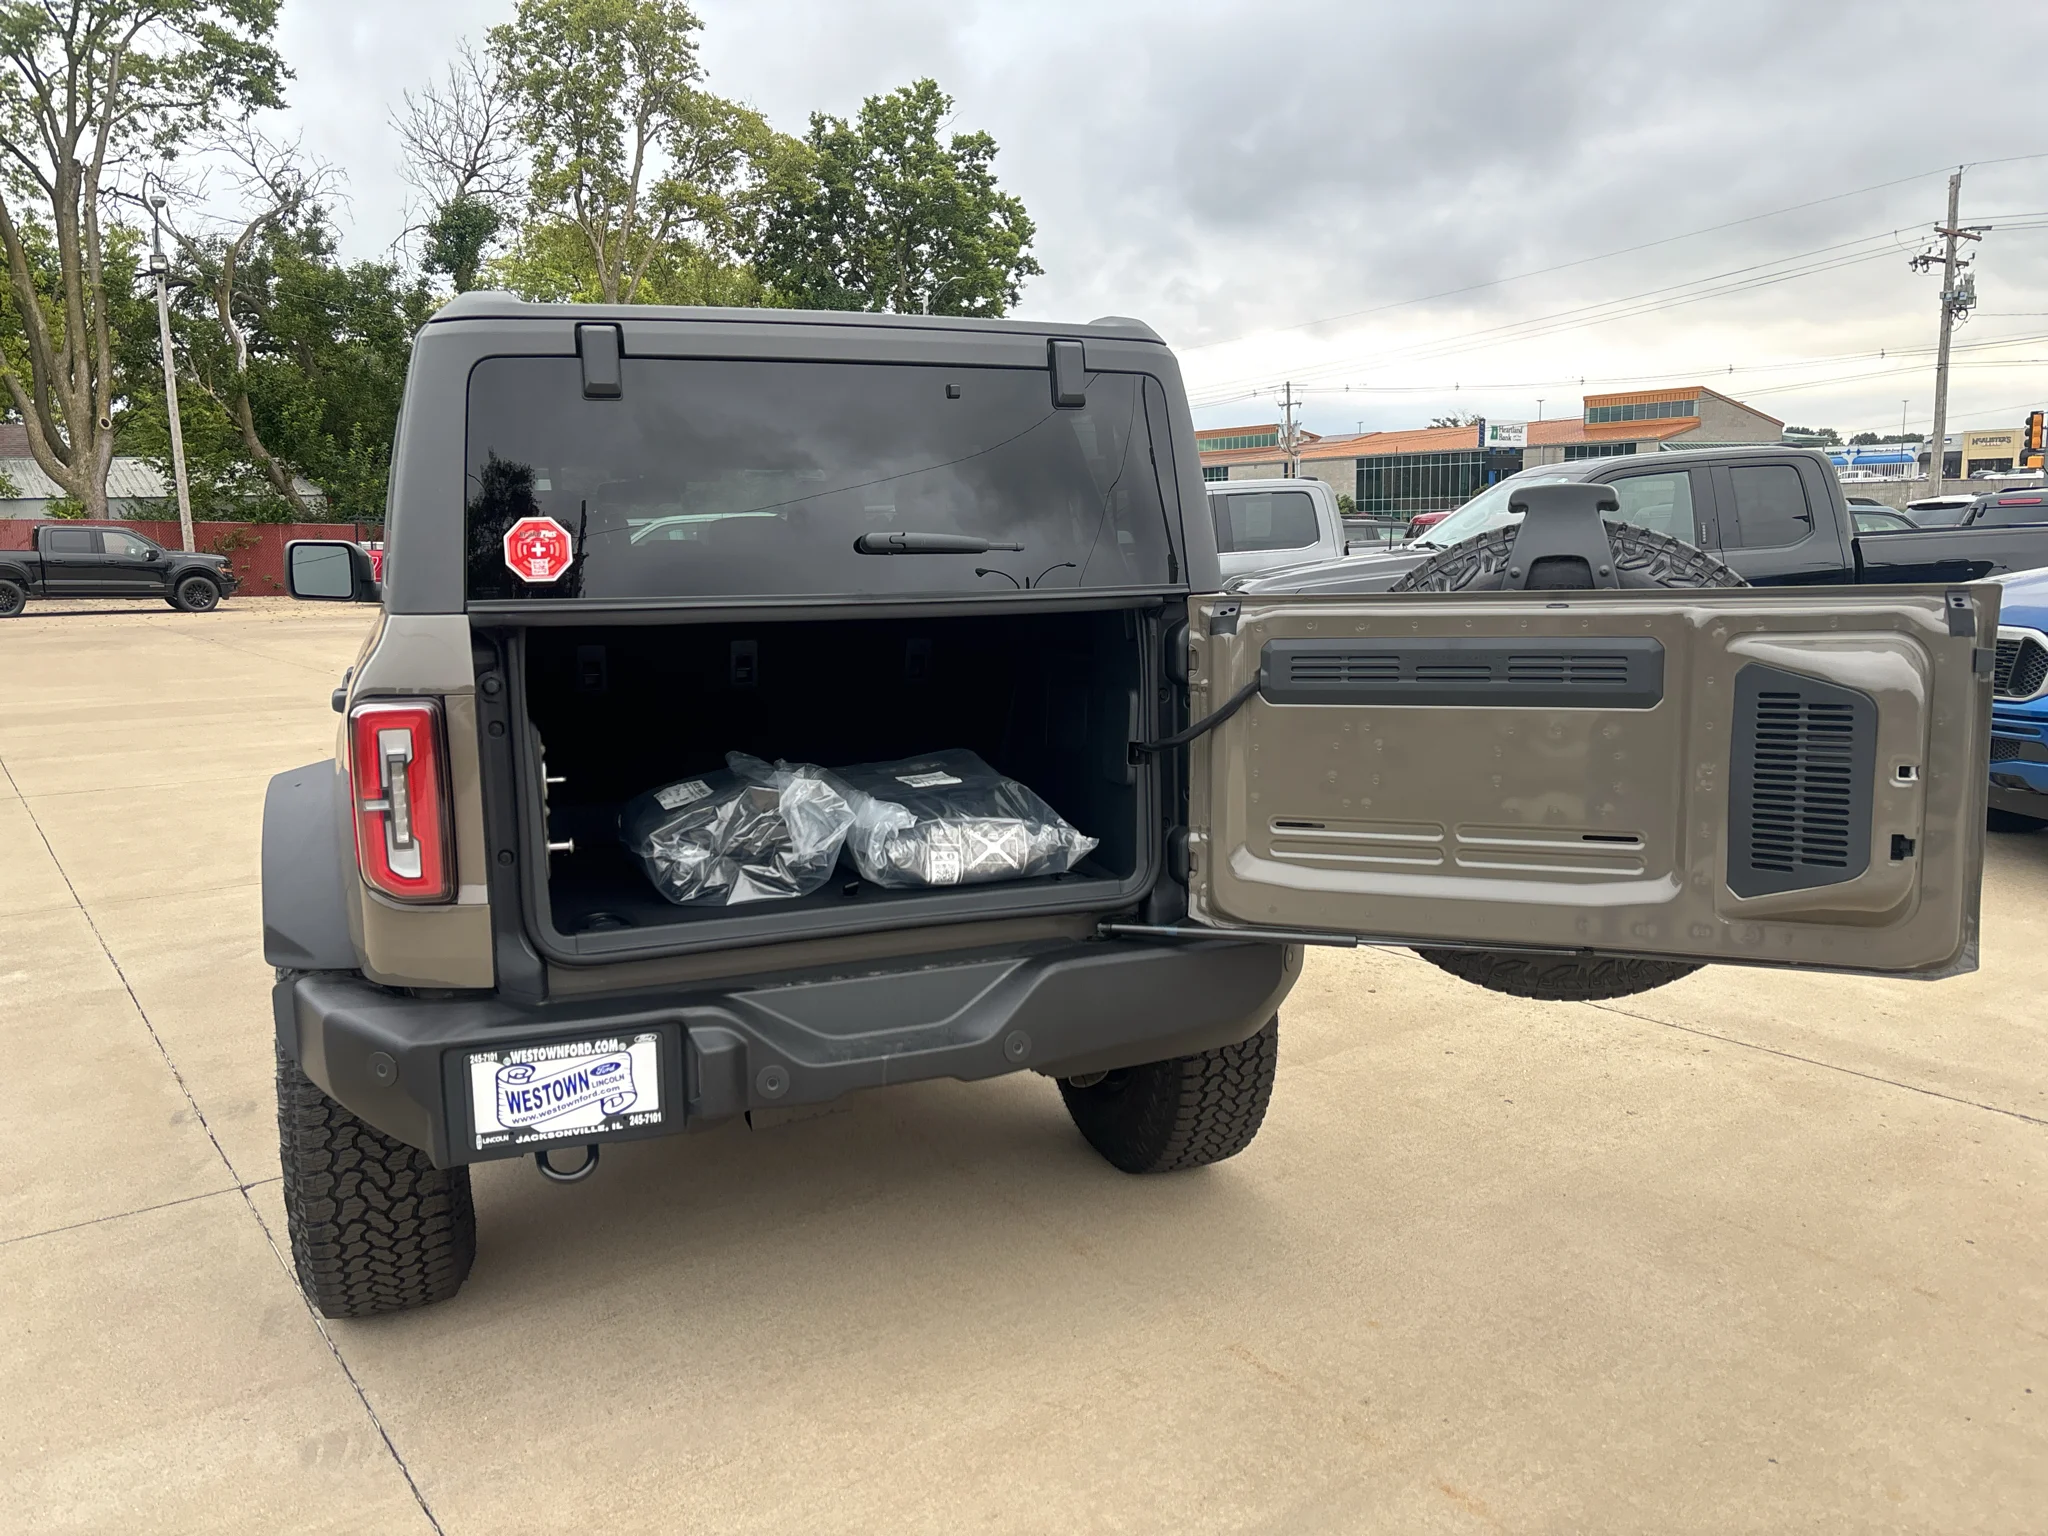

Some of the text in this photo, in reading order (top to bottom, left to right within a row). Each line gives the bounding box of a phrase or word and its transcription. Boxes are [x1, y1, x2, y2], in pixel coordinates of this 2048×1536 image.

[1499, 425, 1523, 433] Heartland
[469, 1038, 618, 1064] 245-7101 WESTOWNFORD.COM
[594, 1063, 616, 1075] Ford
[505, 1069, 625, 1114] WESTOWN LINCOLN
[512, 1085, 620, 1124] www.westownford.com
[482, 1112, 662, 1145] LINCOLN JACKSONVILLE, IL 245-7101
